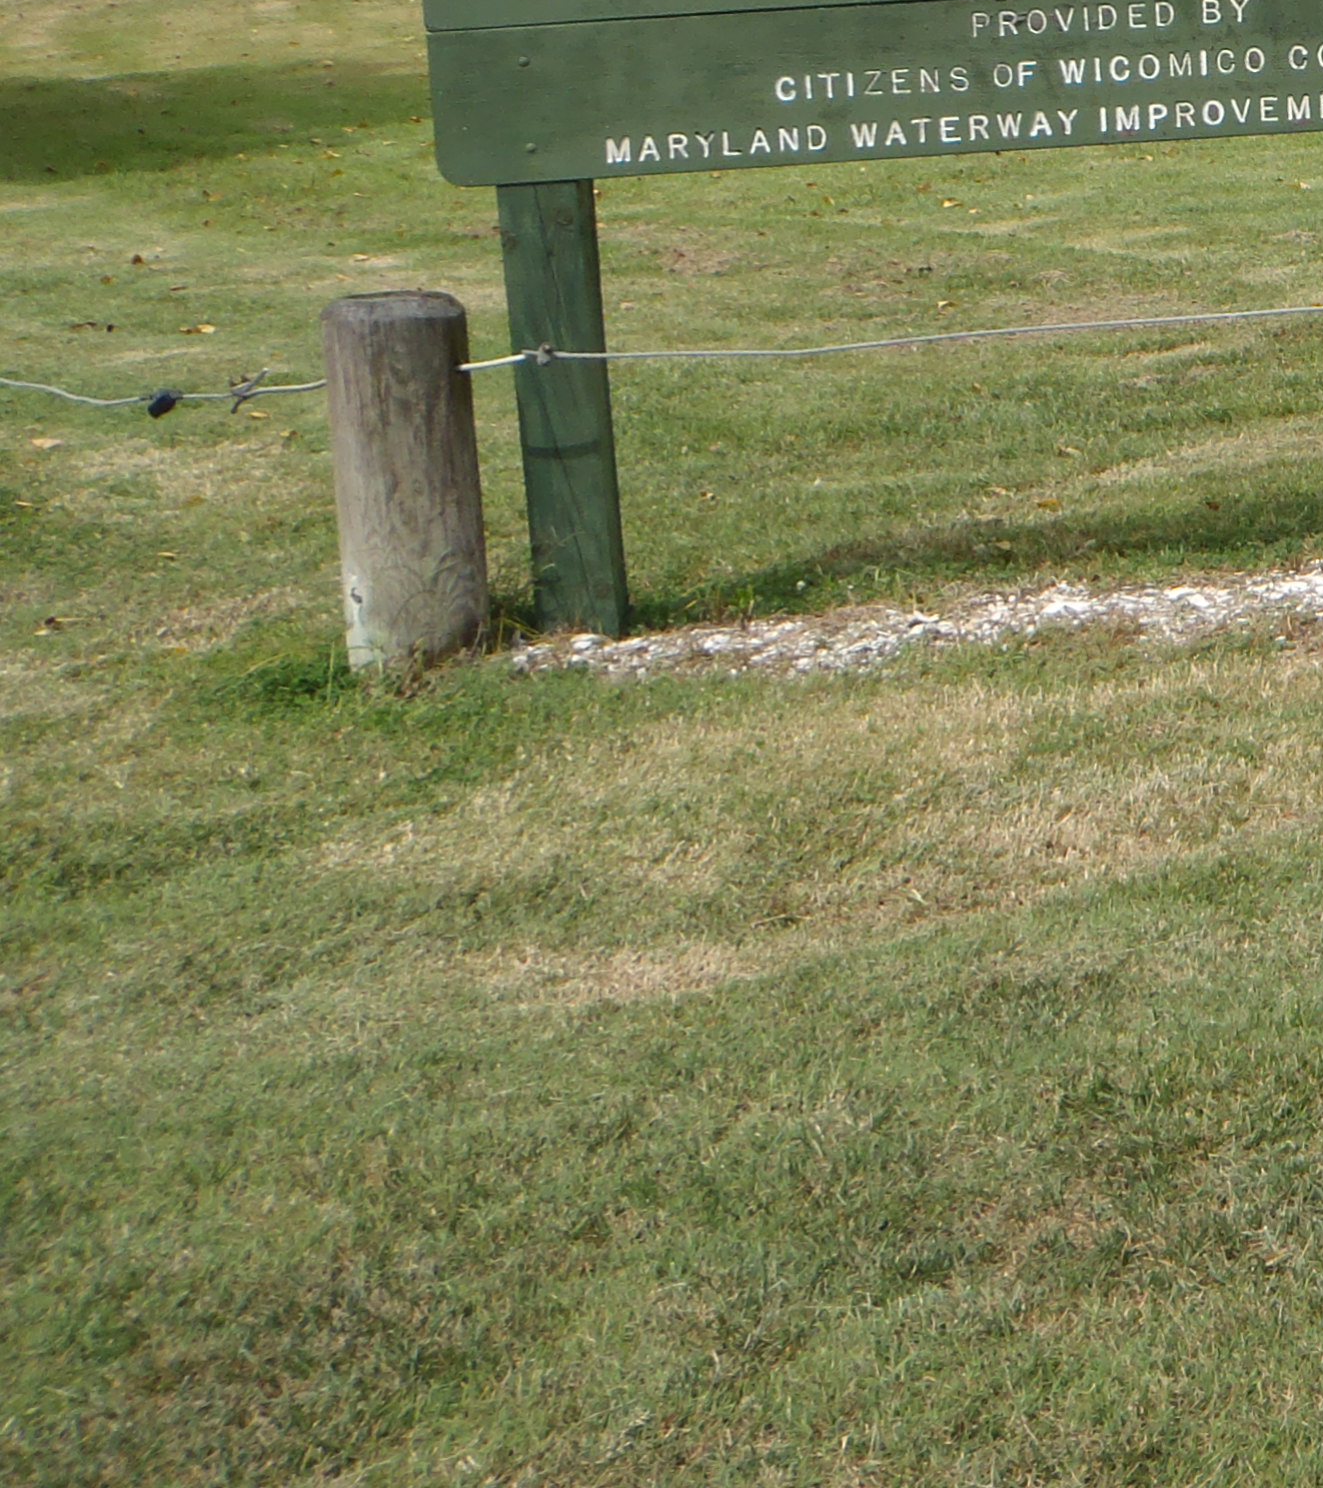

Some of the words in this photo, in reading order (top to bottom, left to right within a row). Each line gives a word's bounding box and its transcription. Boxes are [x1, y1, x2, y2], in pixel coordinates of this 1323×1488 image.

[971, 1, 1175, 38] PROVIDED
[774, 67, 970, 102] CITIZENS
[993, 60, 1038, 88] OF
[1058, 47, 1266, 85] WICOMICO
[605, 125, 828, 165] MARYLAND
[850, 108, 1079, 149] WATERWAY
